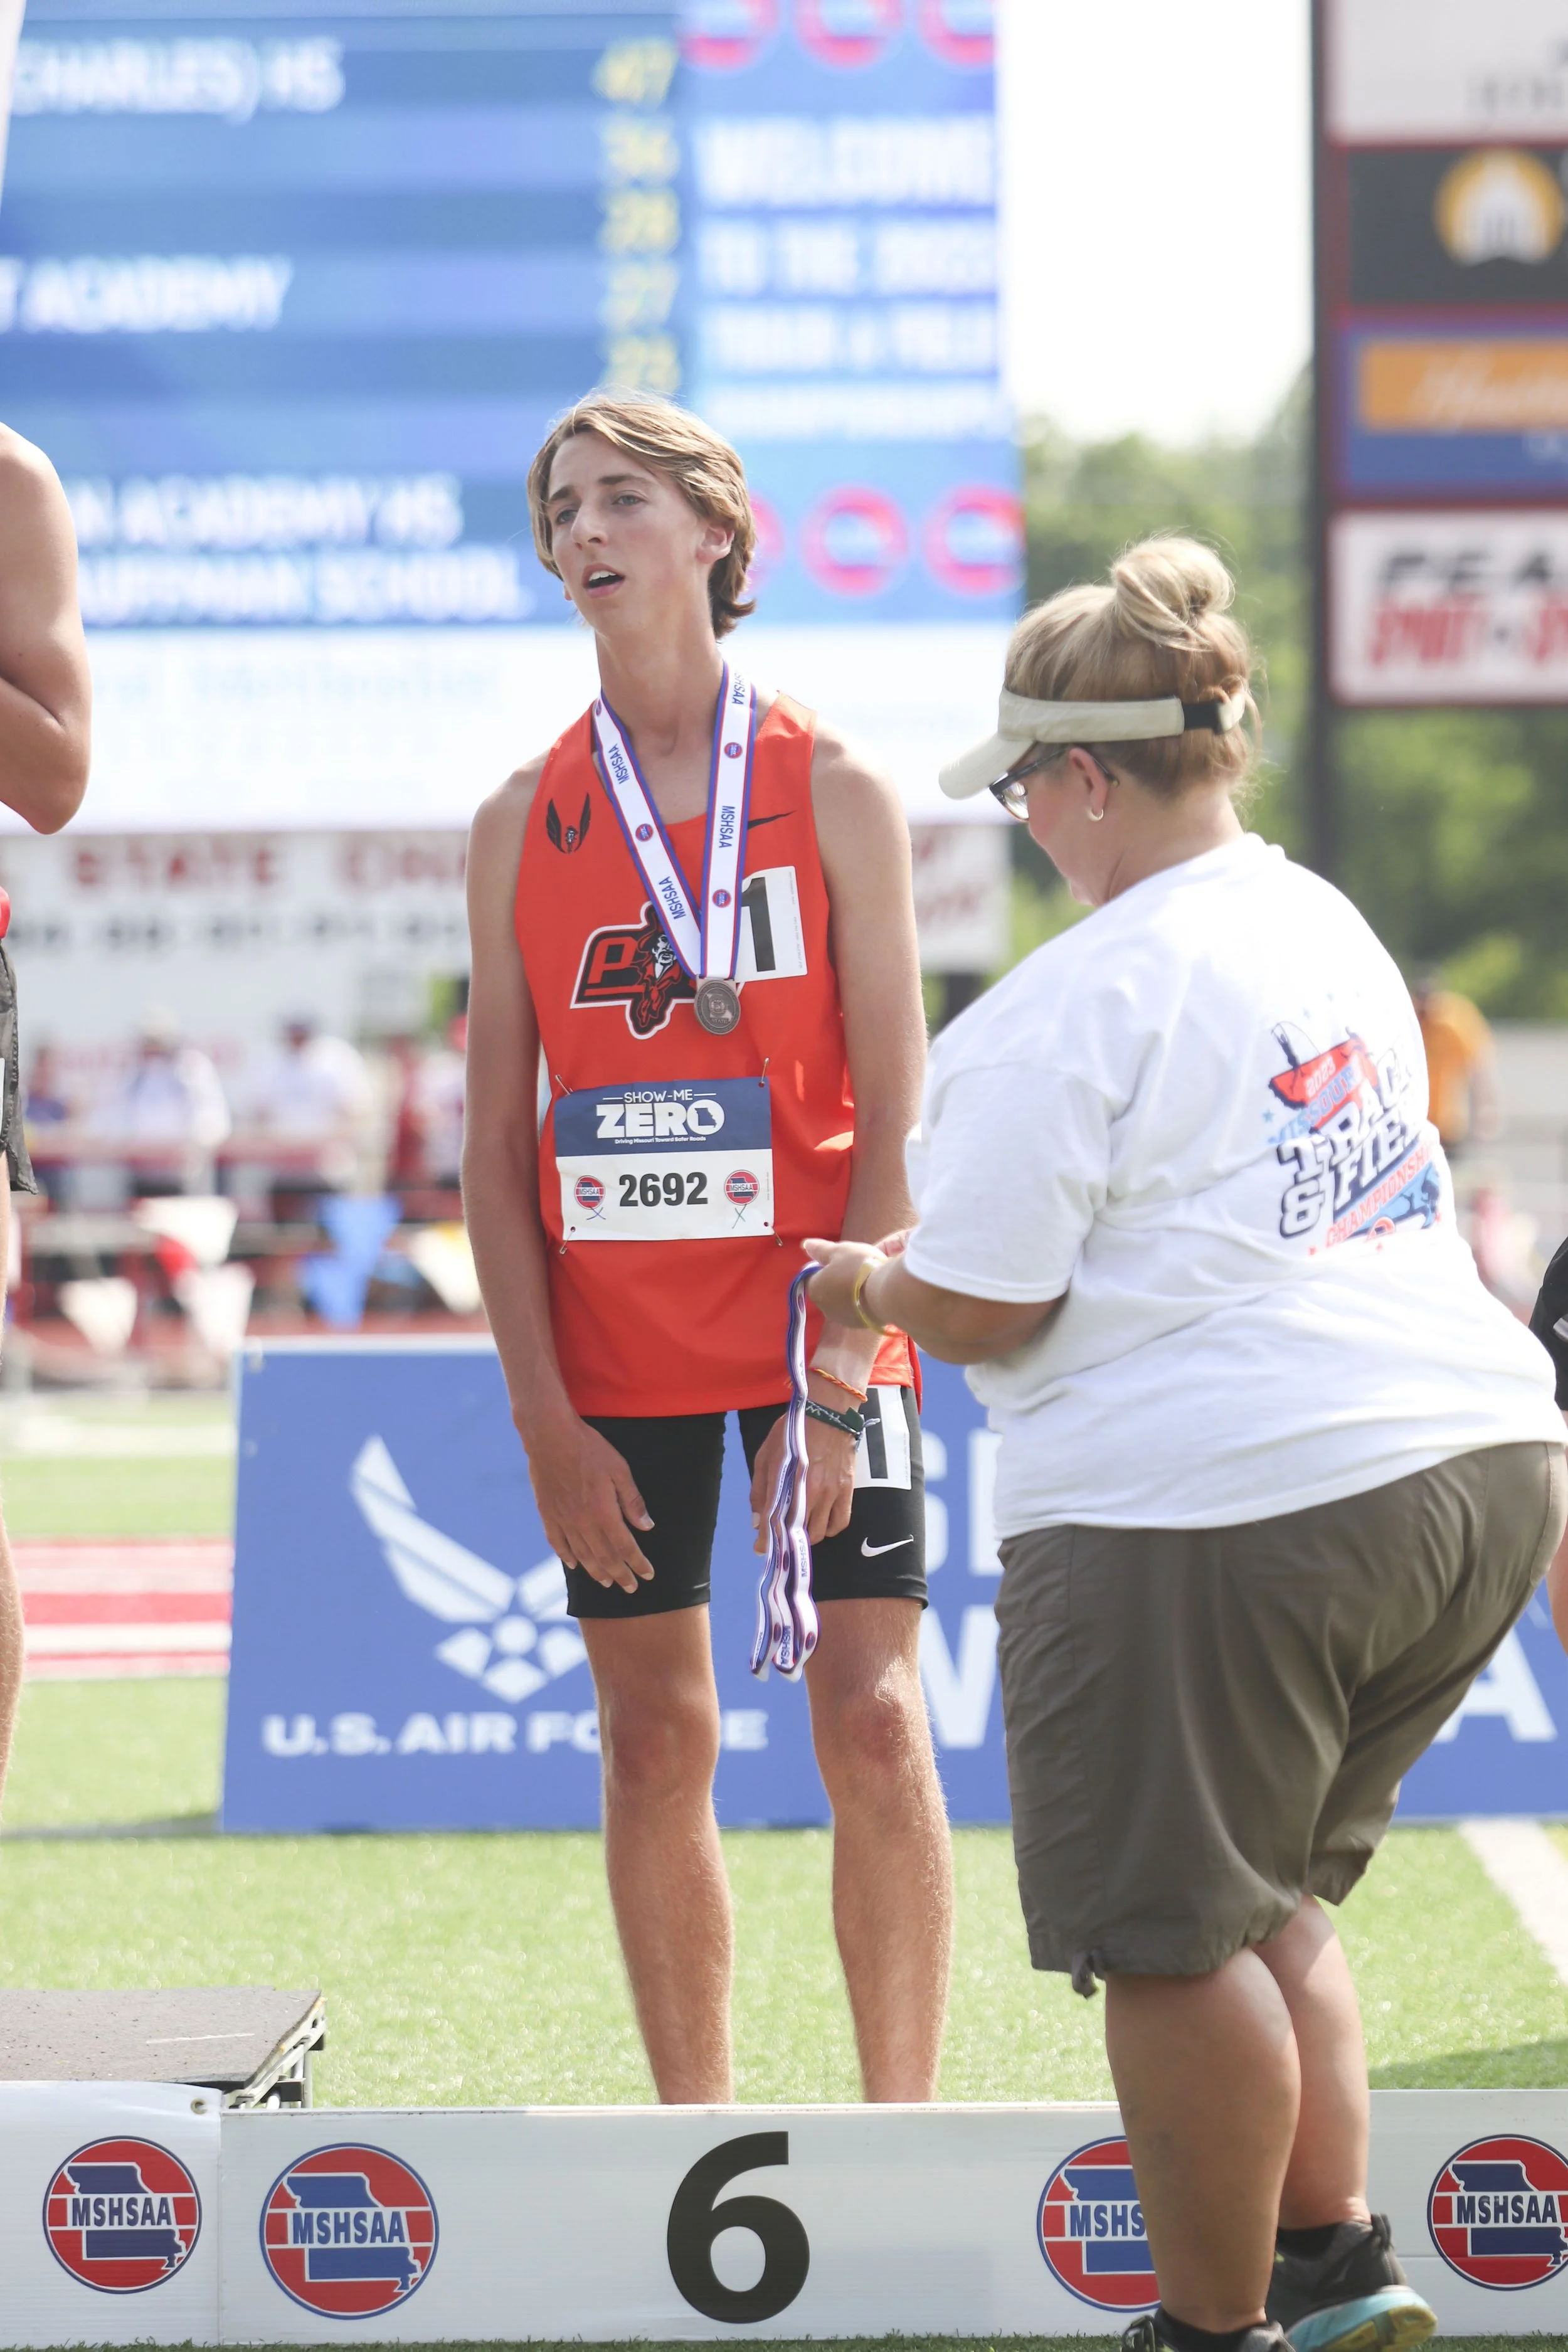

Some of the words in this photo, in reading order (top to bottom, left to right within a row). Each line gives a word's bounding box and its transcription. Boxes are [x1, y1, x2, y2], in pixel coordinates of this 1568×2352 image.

[608, 743, 630, 785] MSHSAA
[719, 805, 736, 849] MSHSAA
[658, 876, 687, 921] MSHSAA
[623, 1089, 694, 1103] SHOW-ME
[596, 1099, 726, 1139] ZERO
[579, 1187, 600, 1195] MSHSAA
[618, 1172, 709, 1207] 2692
[729, 1184, 753, 1192] MSHSAA
[398, 1712, 517, 1754] AIR
[526, 1710, 770, 1754] FOE
[72, 2196, 172, 2227] MSHSAA
[667, 2130, 810, 2324] 6
[1069, 2204, 1147, 2238] MSHS
[1456, 2194, 1559, 2225] MSHSAA
[292, 2210, 406, 2245] MSHSAA
